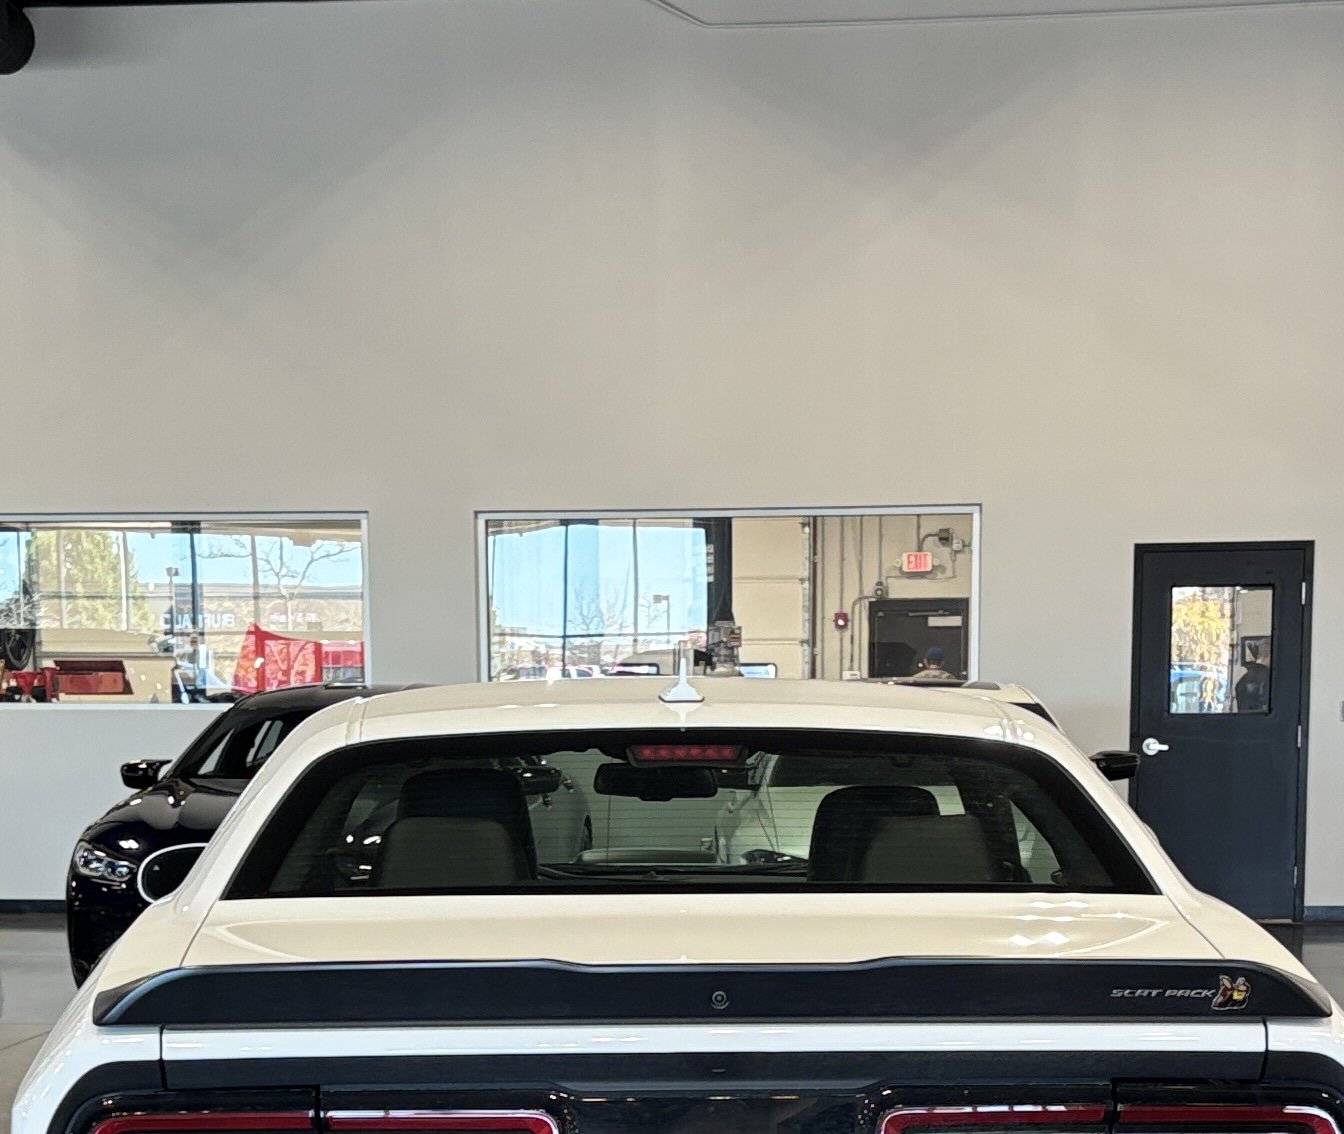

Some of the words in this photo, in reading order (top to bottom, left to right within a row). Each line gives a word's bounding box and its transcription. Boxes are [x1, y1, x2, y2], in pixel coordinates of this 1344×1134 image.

[906, 553, 929, 570] EXIT
[1109, 988, 1163, 998] SCAT
[1164, 988, 1217, 998] PACK
